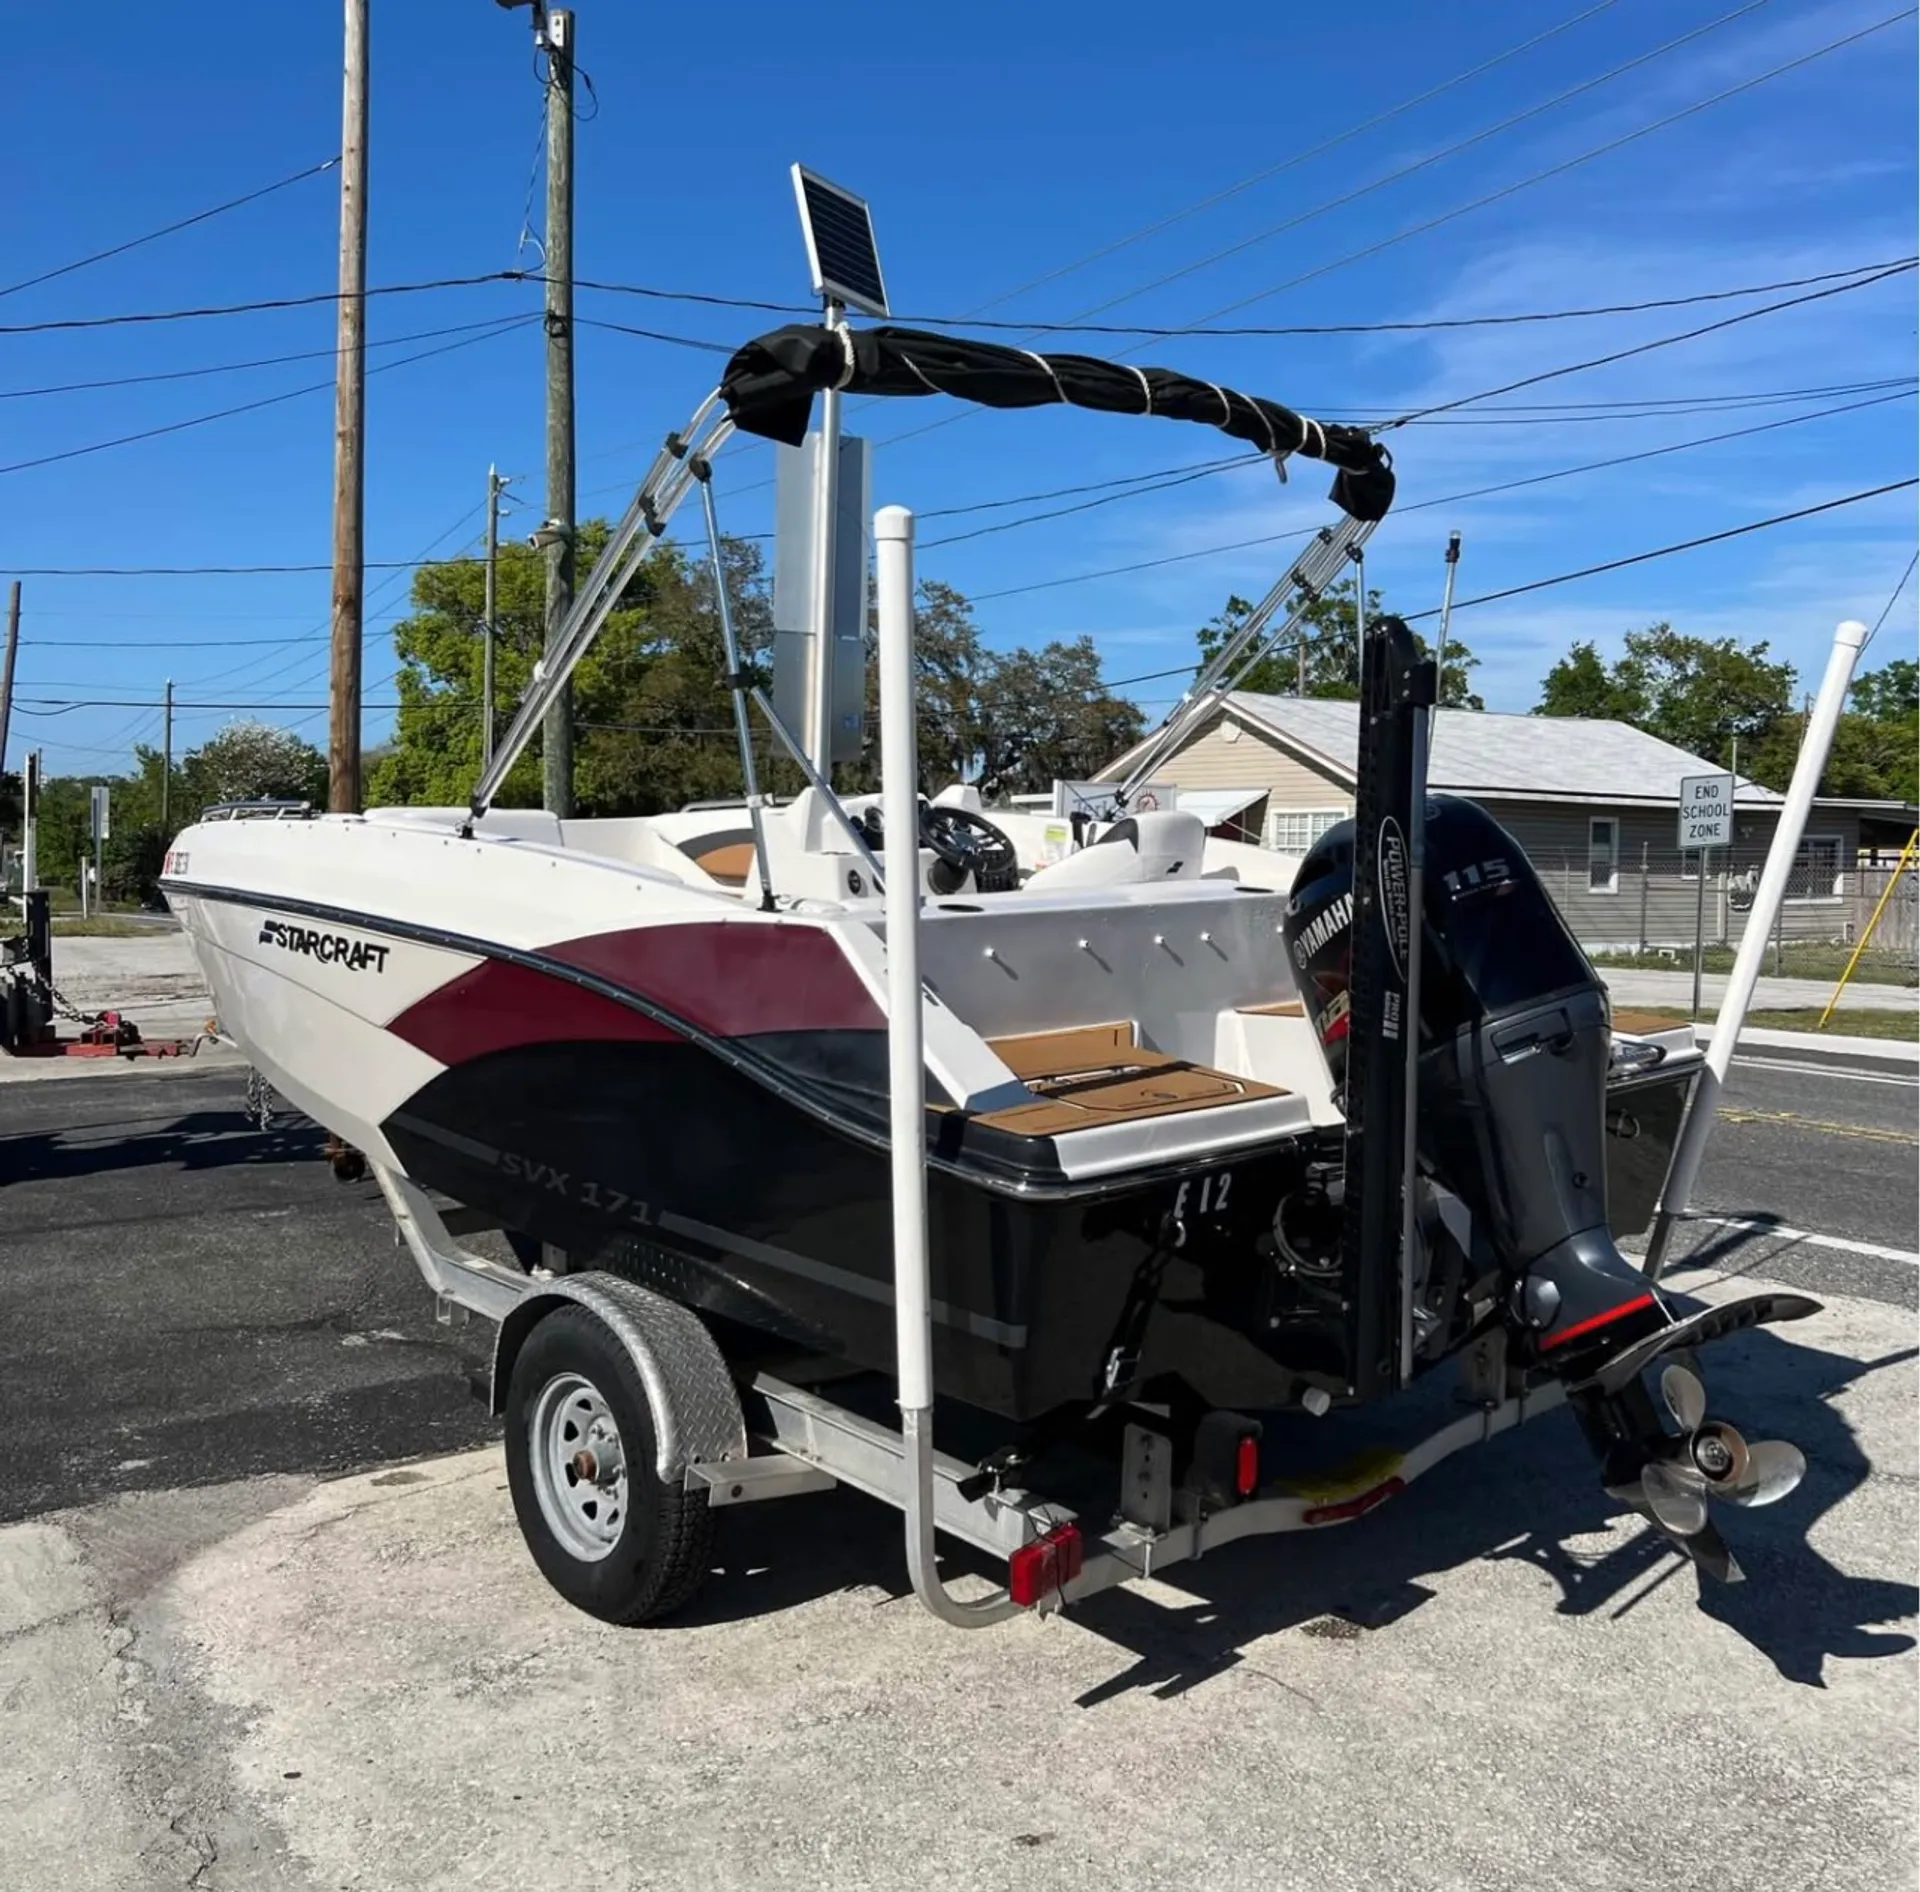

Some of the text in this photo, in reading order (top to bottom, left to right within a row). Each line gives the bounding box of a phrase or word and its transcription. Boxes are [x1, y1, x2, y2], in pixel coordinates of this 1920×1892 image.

[1695, 785, 1720, 799] END
[1683, 803, 1729, 819] SCHOOL
[1690, 823, 1721, 838] ZONE
[1442, 858, 1510, 892] 115
[1386, 836, 1408, 960] POWER-POLE
[275, 923, 390, 974] STARCRAFT
[502, 1152, 652, 1225] SVX 171
